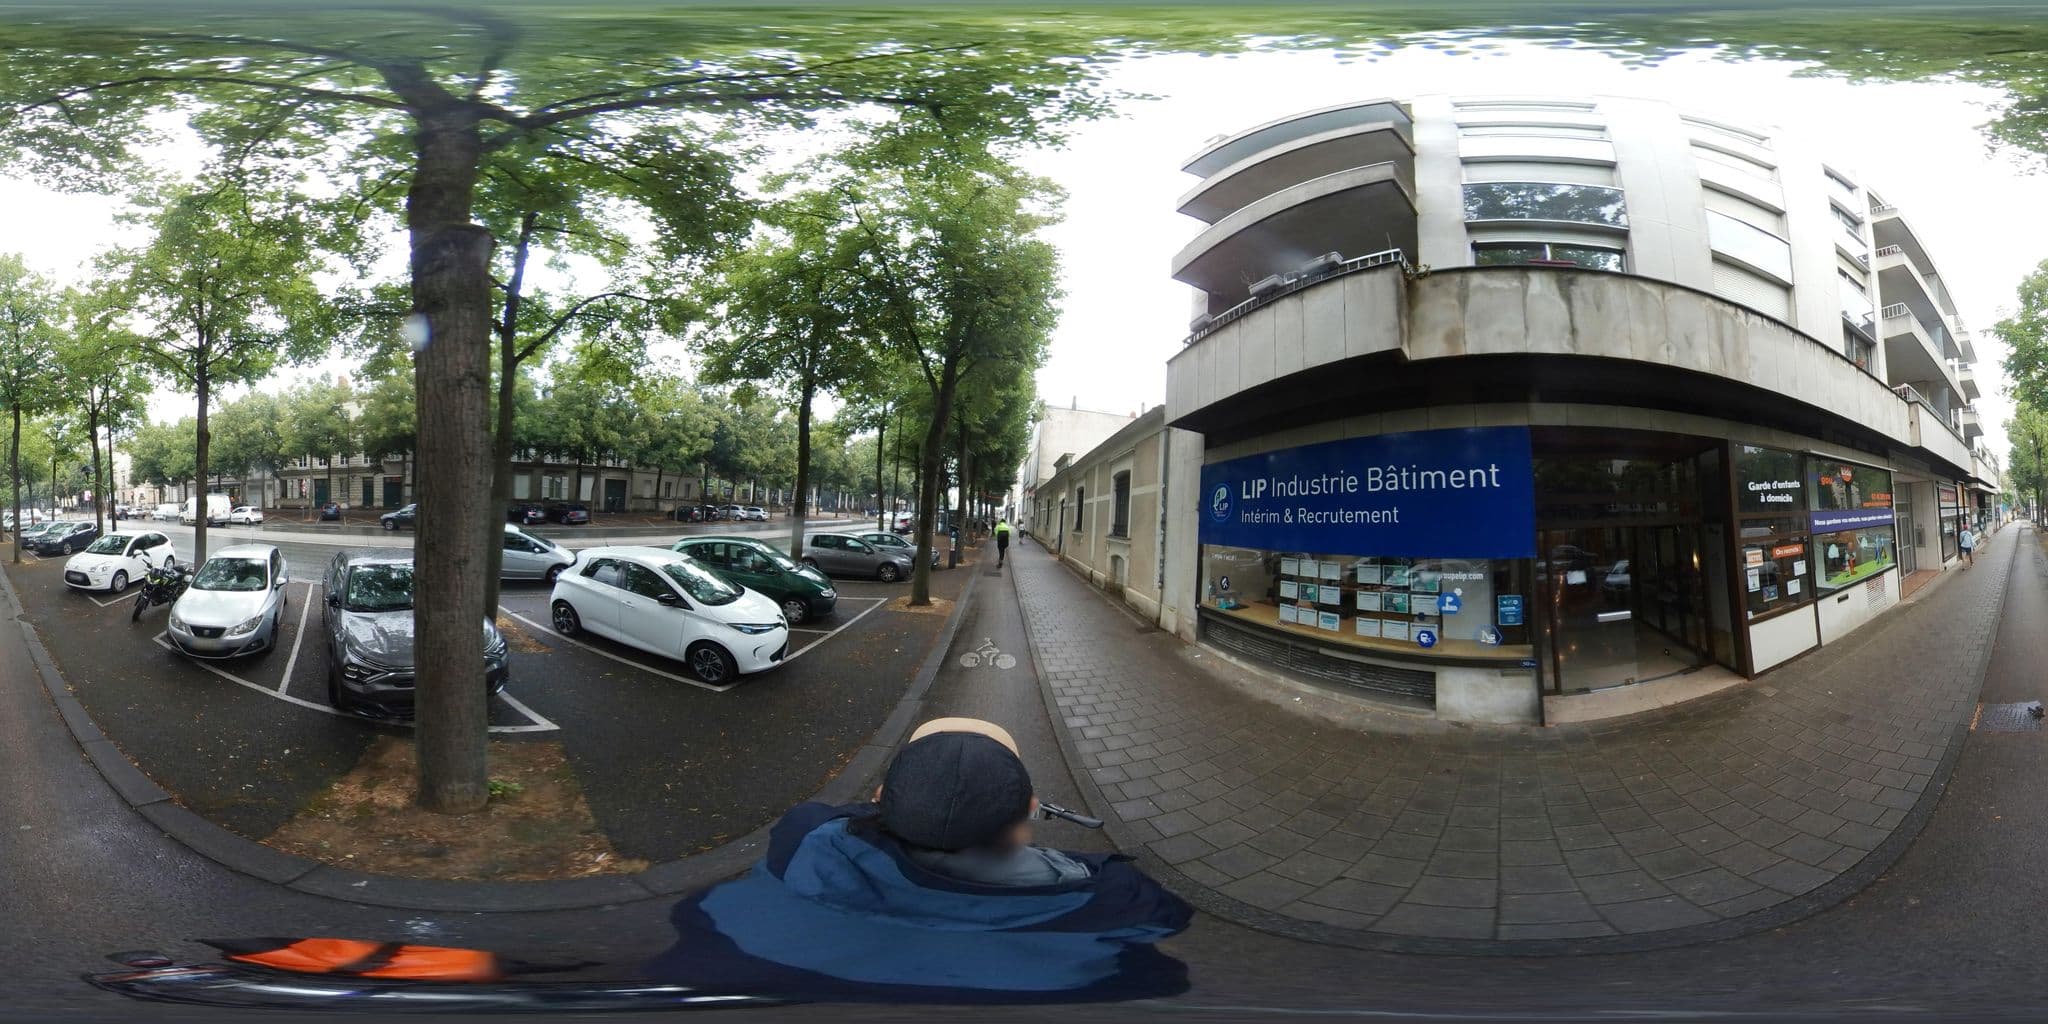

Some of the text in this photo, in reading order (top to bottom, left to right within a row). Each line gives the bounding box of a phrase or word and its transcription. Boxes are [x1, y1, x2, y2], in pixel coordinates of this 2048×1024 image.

[1242, 464, 1500, 499] LIP Industrie Bâtiment
[1748, 480, 1800, 491] Garde d'enfants
[1760, 493, 1793, 502] à domicile
[1219, 503, 1229, 511] LIP
[1241, 507, 1399, 524] Intérim & Recrutement
